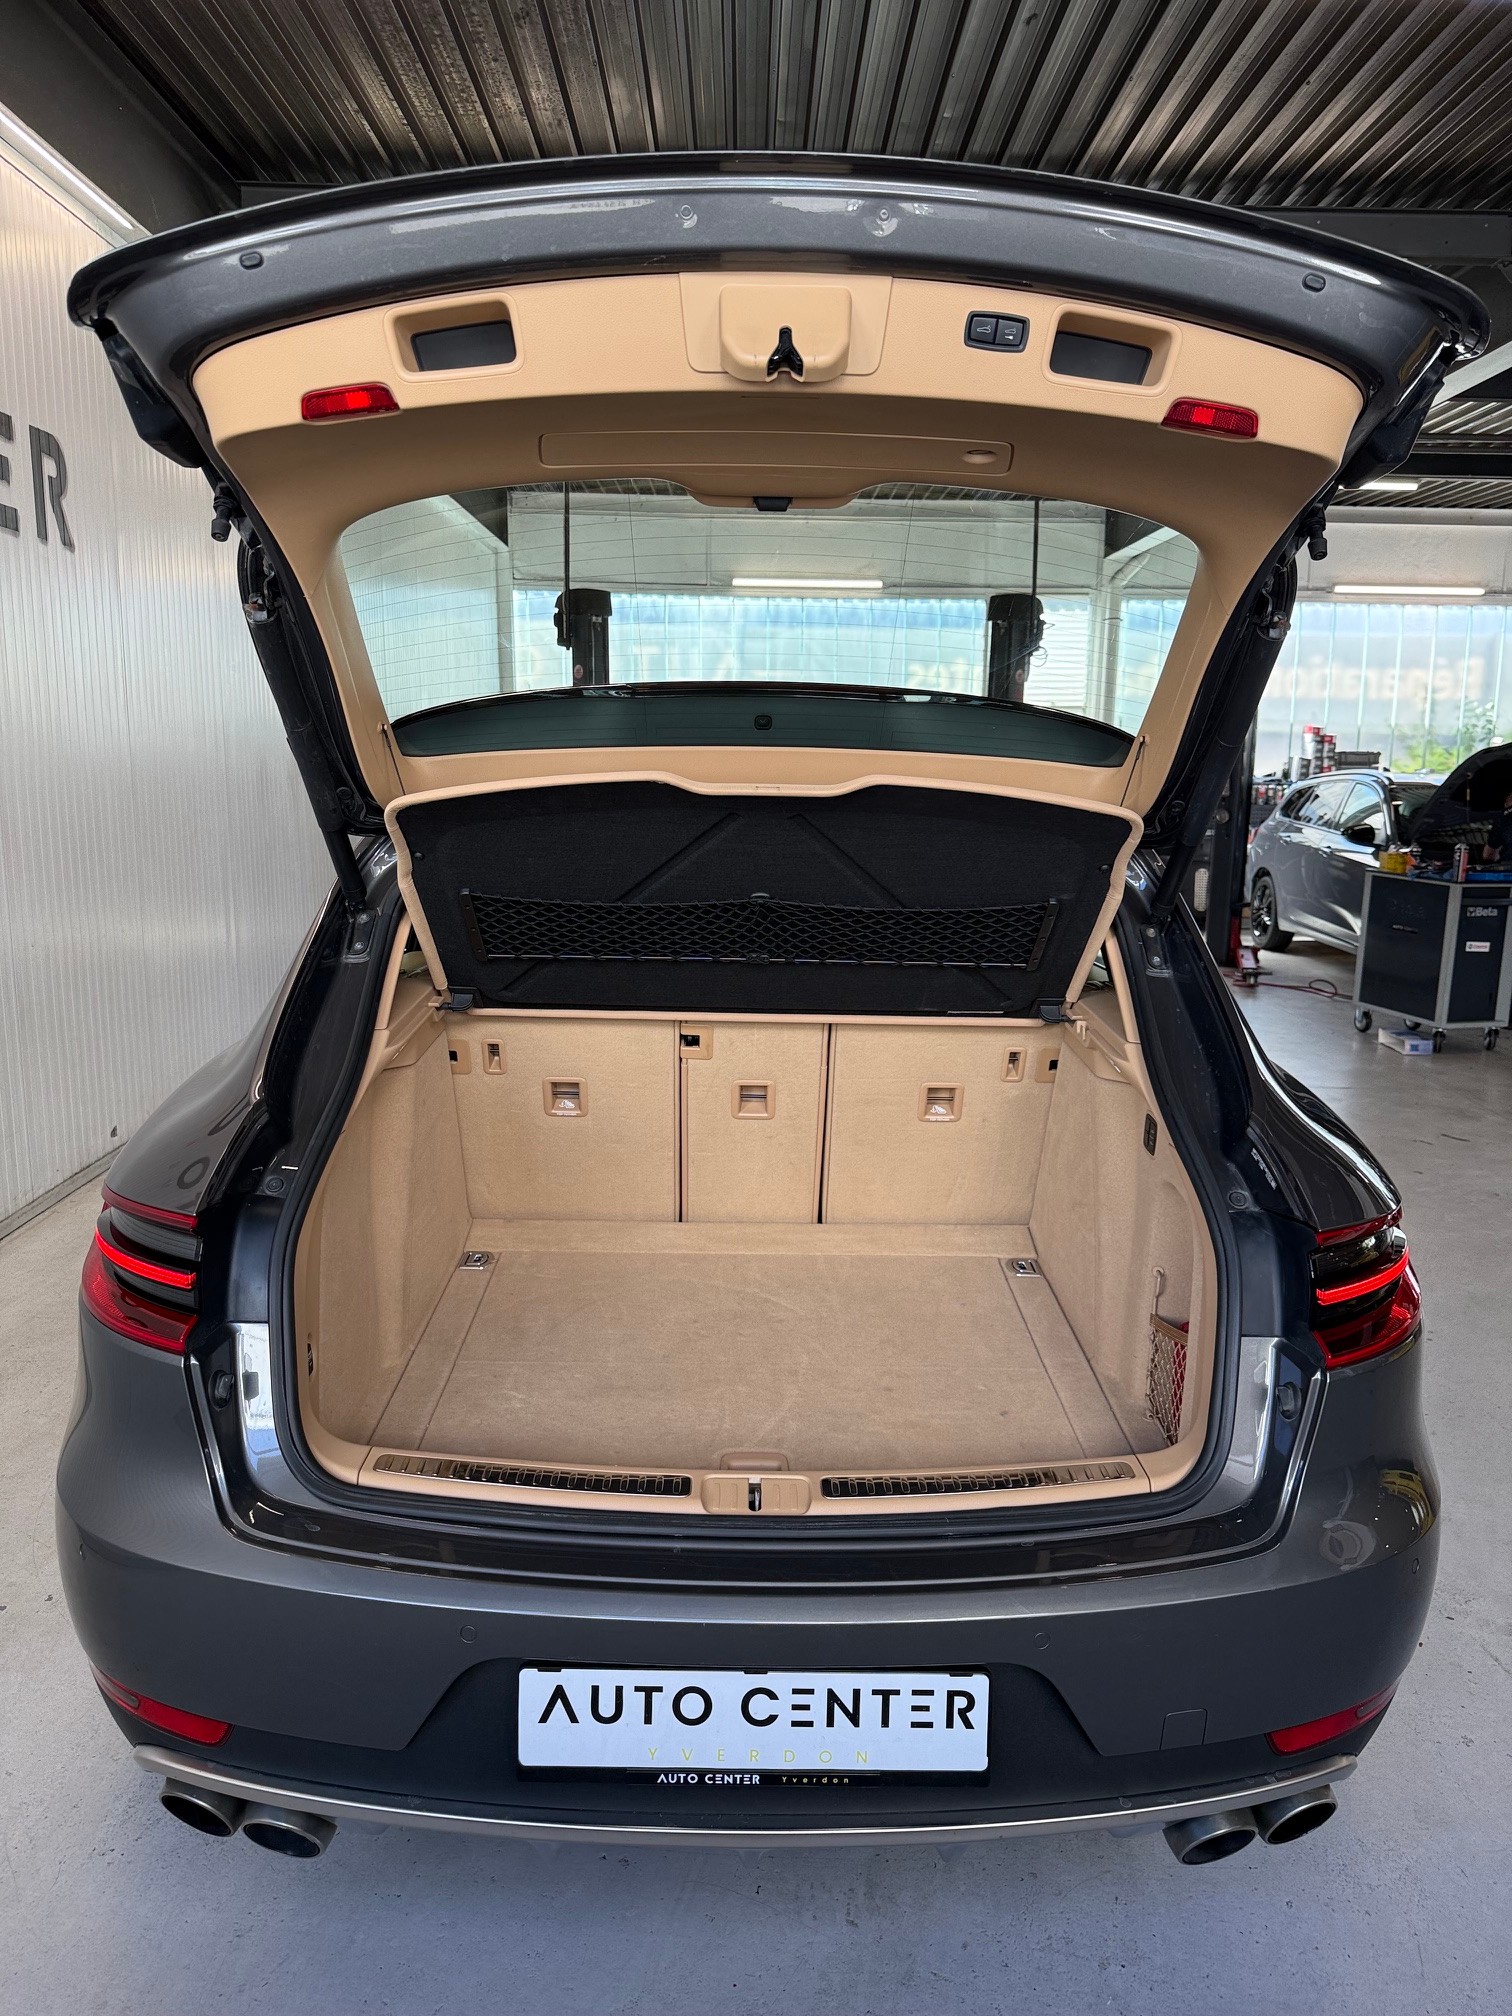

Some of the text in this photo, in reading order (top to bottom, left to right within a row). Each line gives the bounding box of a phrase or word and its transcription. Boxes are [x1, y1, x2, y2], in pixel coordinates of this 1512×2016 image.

[1476, 907, 1498, 917] Beta
[537, 1684, 976, 1730] AUTO CENTER
[656, 1773, 851, 1785] AUTO CENTER Yverdon
